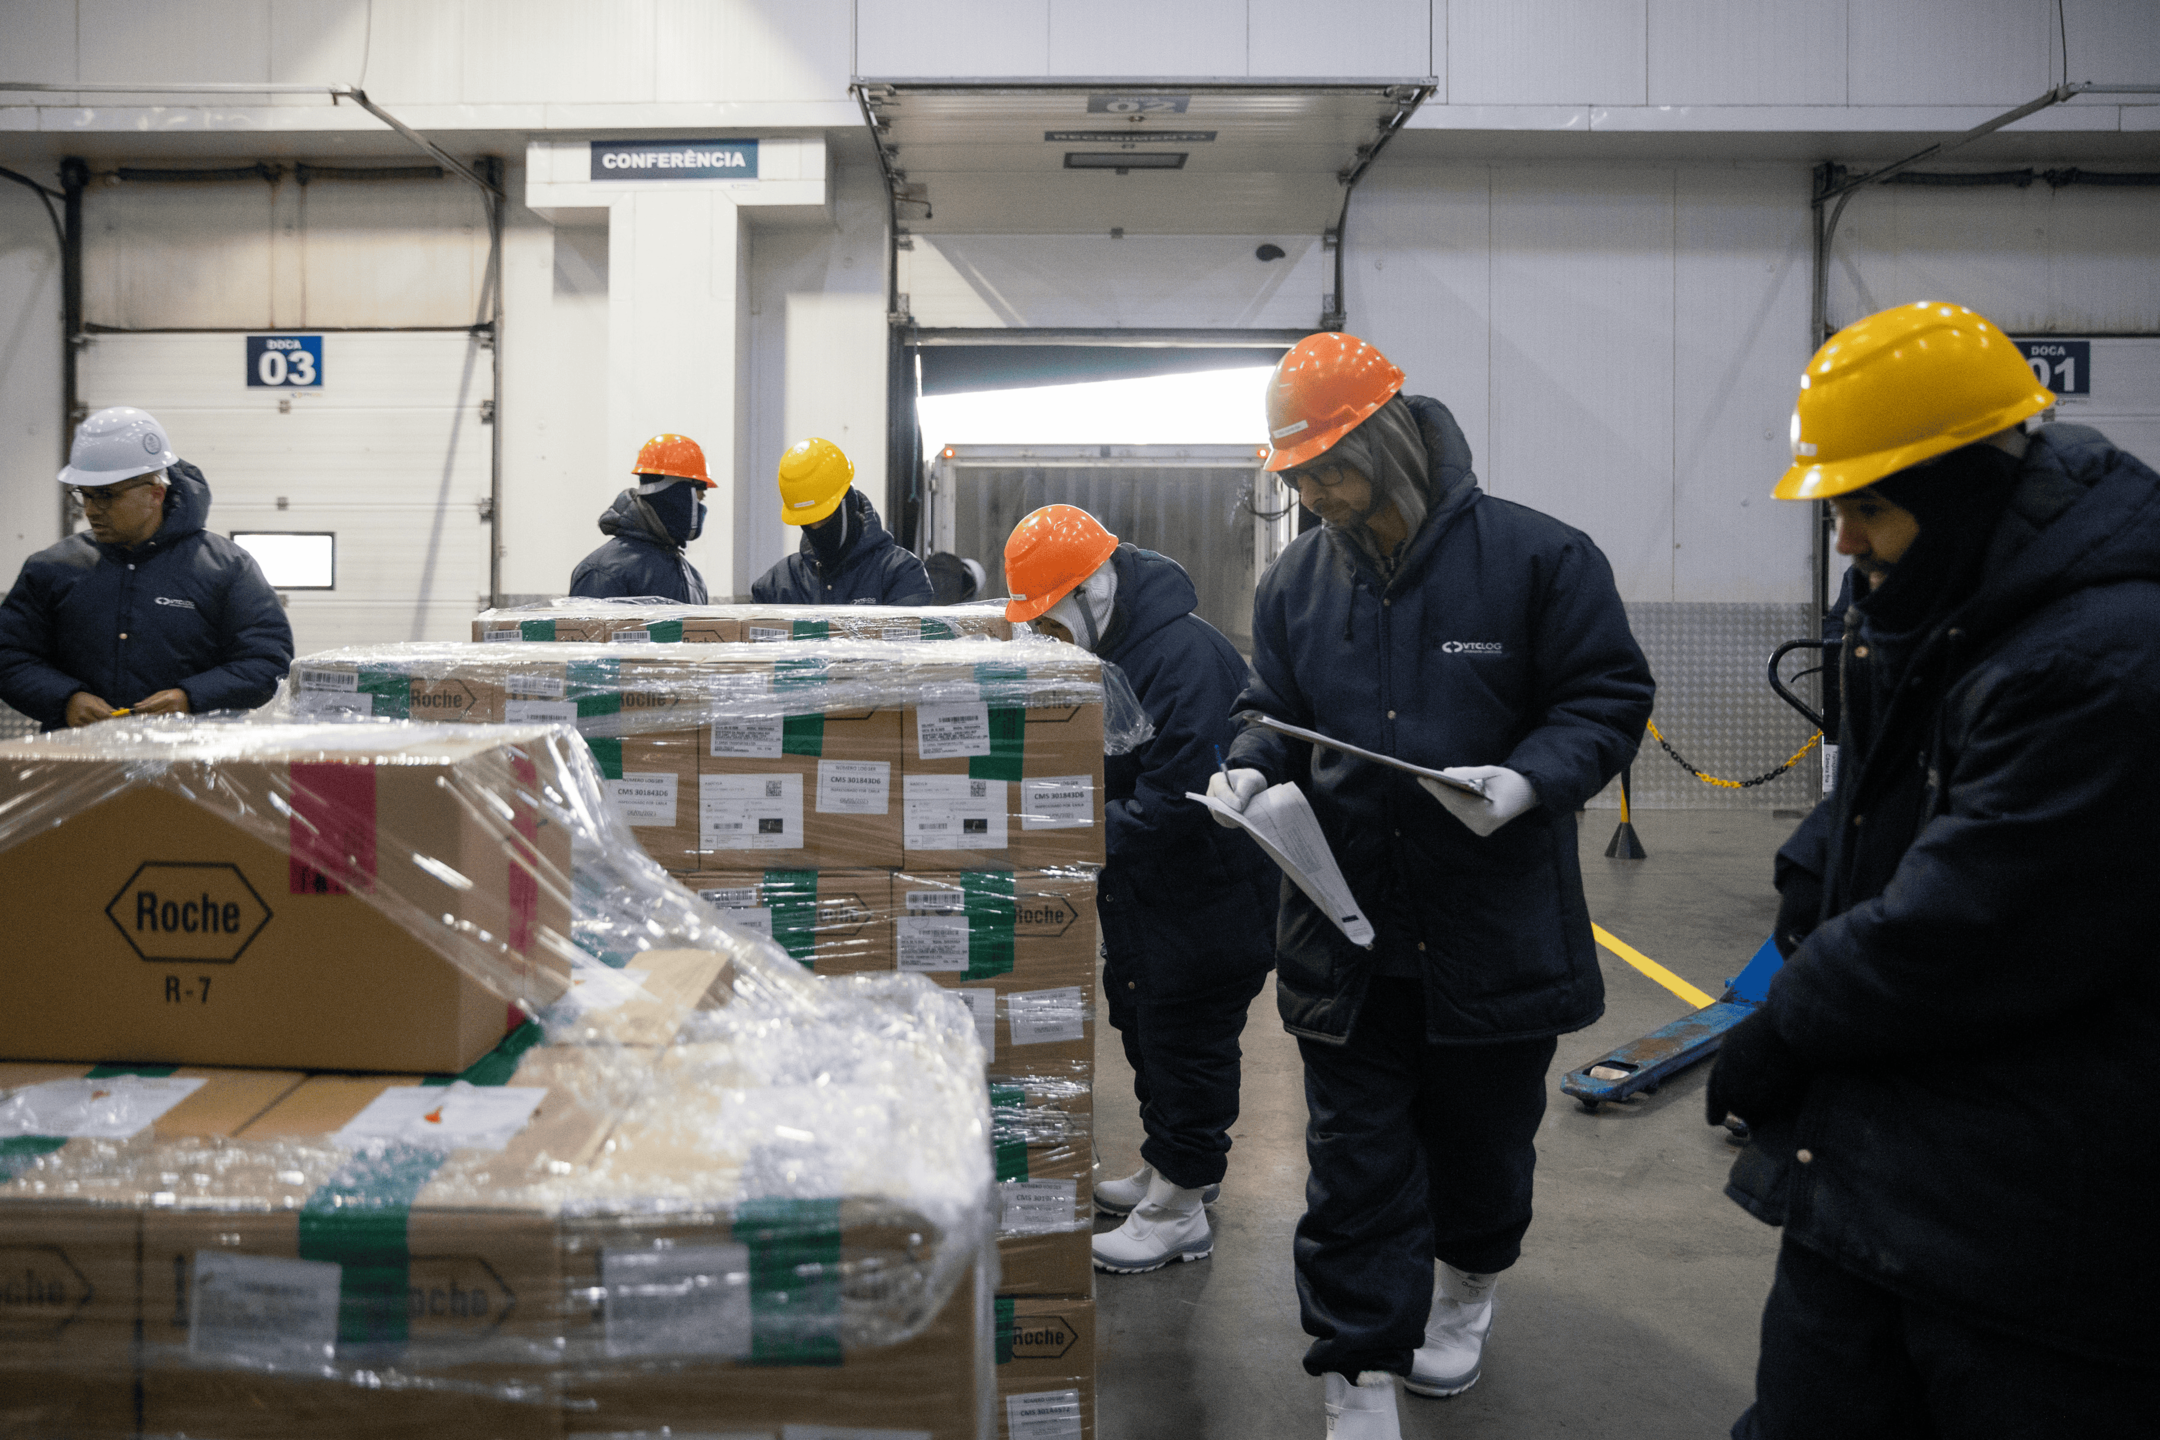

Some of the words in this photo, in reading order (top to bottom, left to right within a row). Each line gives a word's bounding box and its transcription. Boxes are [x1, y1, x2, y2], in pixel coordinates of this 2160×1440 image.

[602, 149, 746, 169] CONFERÊNCIA
[266, 339, 302, 350] DOCA
[2031, 346, 2066, 356] DOCA
[259, 350, 316, 386] 03
[1463, 642, 1502, 650] VTCLOG
[411, 688, 463, 708] Roche
[617, 788, 634, 796] CMS
[137, 891, 240, 933] Roche
[1014, 904, 1064, 924] Roche
[165, 975, 212, 1003] R-7
[1013, 1327, 1064, 1345] Roche
